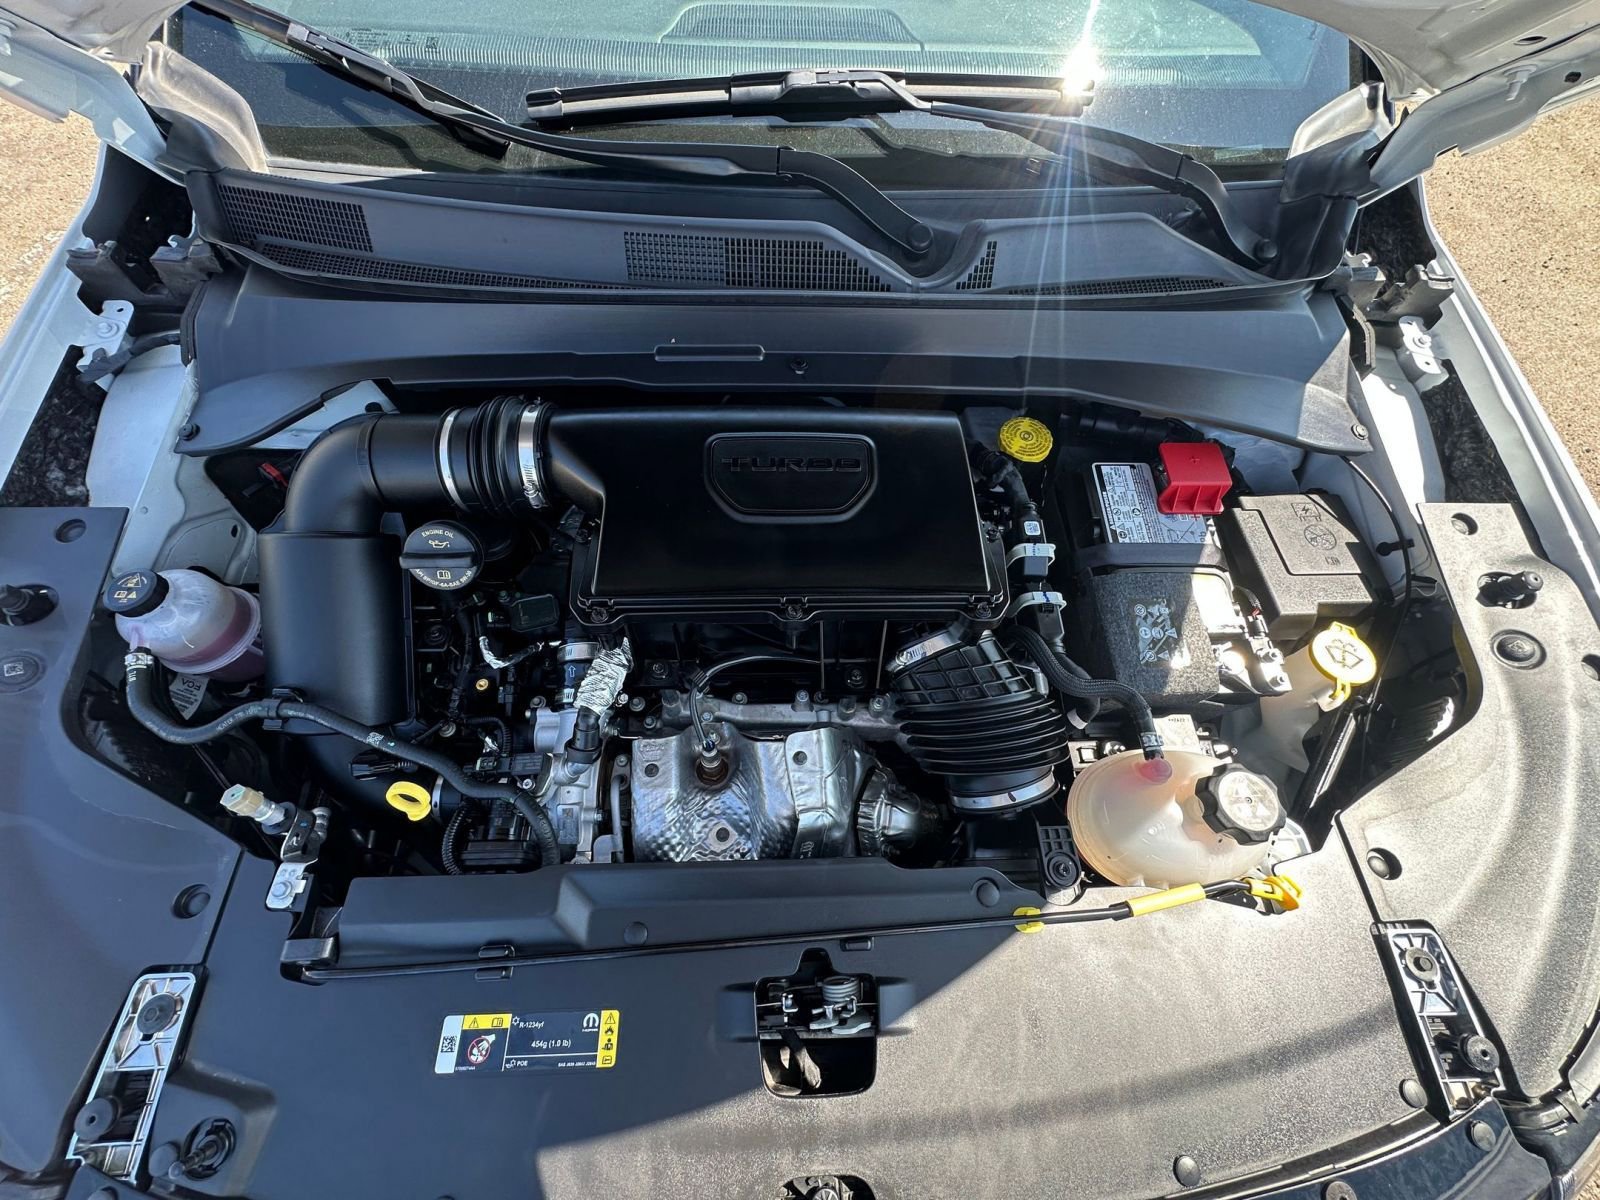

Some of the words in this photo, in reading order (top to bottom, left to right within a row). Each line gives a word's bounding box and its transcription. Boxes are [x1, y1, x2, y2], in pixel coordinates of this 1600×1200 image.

[721, 456, 862, 472] TURBO
[421, 529, 444, 537] ENGINE
[444, 530, 454, 538] OIL
[519, 1021, 545, 1029] R-1234yf
[531, 1040, 548, 1048] 454g
[548, 1039, 561, 1048] (1.0
[562, 1039, 571, 1048] lb)
